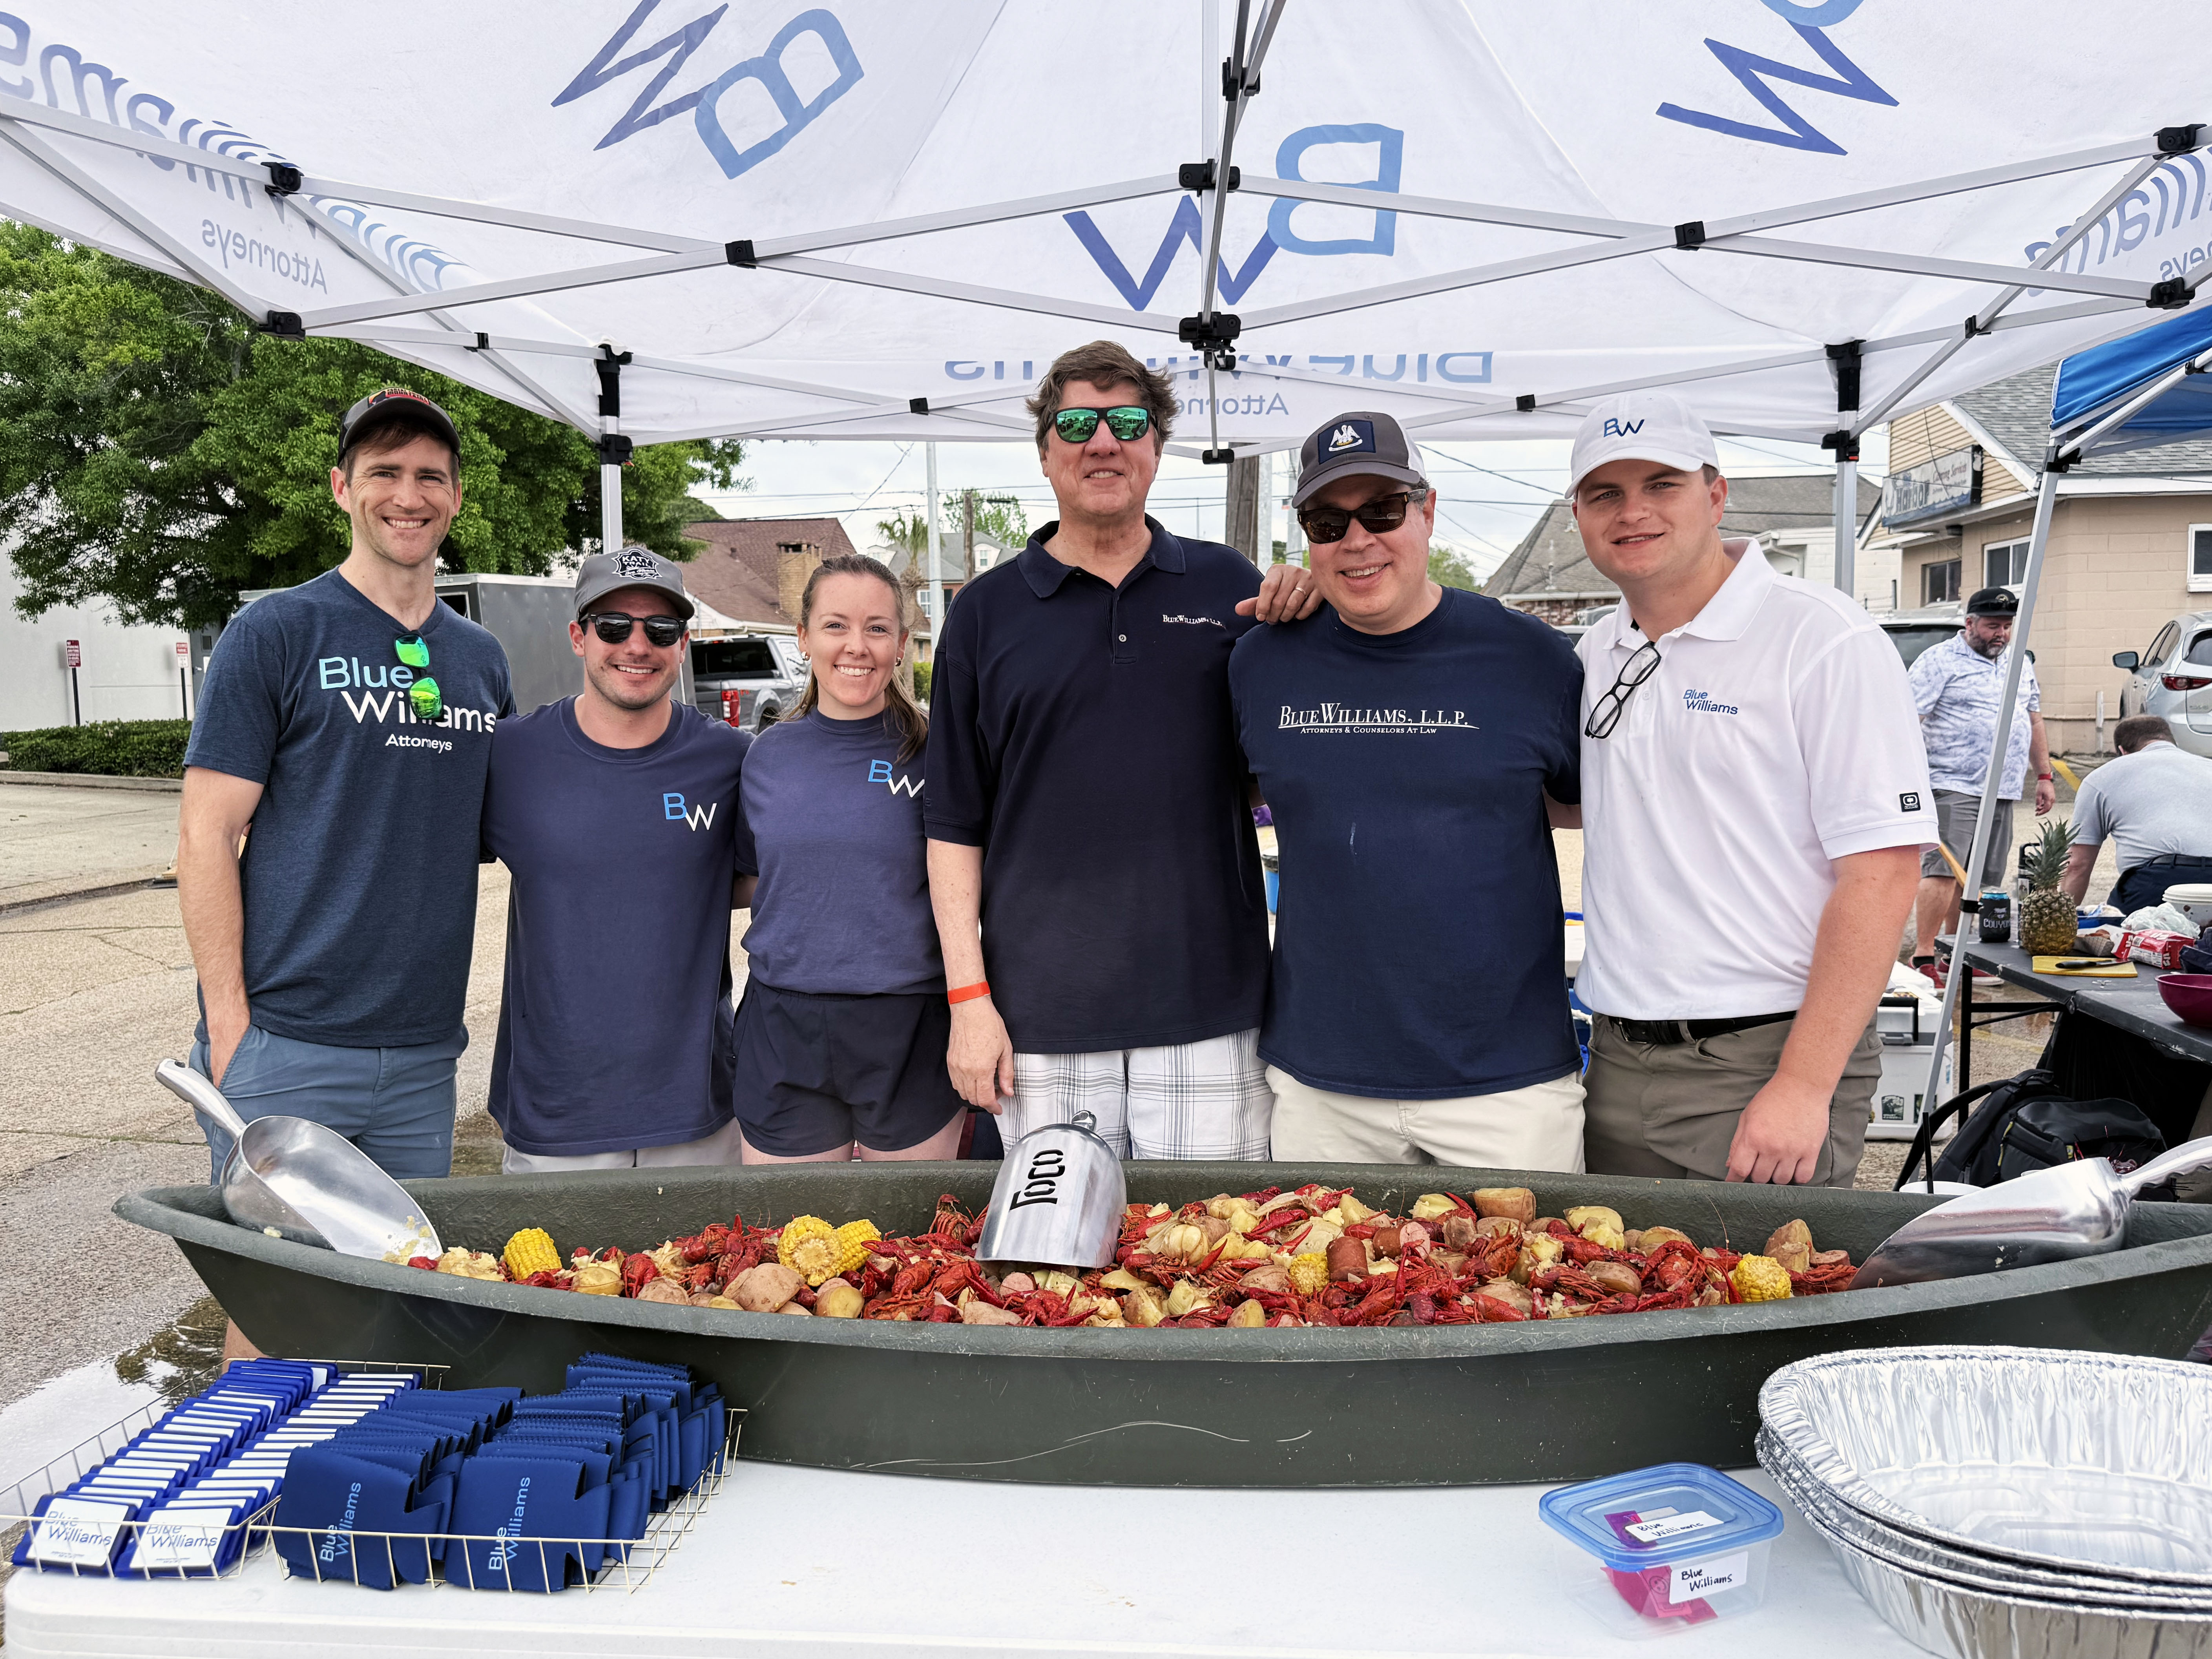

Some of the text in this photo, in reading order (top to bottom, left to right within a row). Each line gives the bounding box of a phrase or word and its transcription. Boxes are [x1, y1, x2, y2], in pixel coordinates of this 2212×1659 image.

[1604, 418, 1644, 437] BW
[319, 657, 413, 690] Blue
[1683, 689, 1708, 699] Blue
[341, 691, 496, 733] Wiams
[1686, 699, 1738, 715] Williams
[1420, 710, 1468, 726] L.L.P.
[868, 759, 925, 798] BW
[663, 793, 717, 832] BW
[506, 1477, 530, 1560] Williams
[48, 1526, 112, 1546] Williams
[151, 1534, 218, 1548] Williams
[1681, 1569, 1703, 1580] Blue
[1690, 1573, 1732, 1592] Williams
